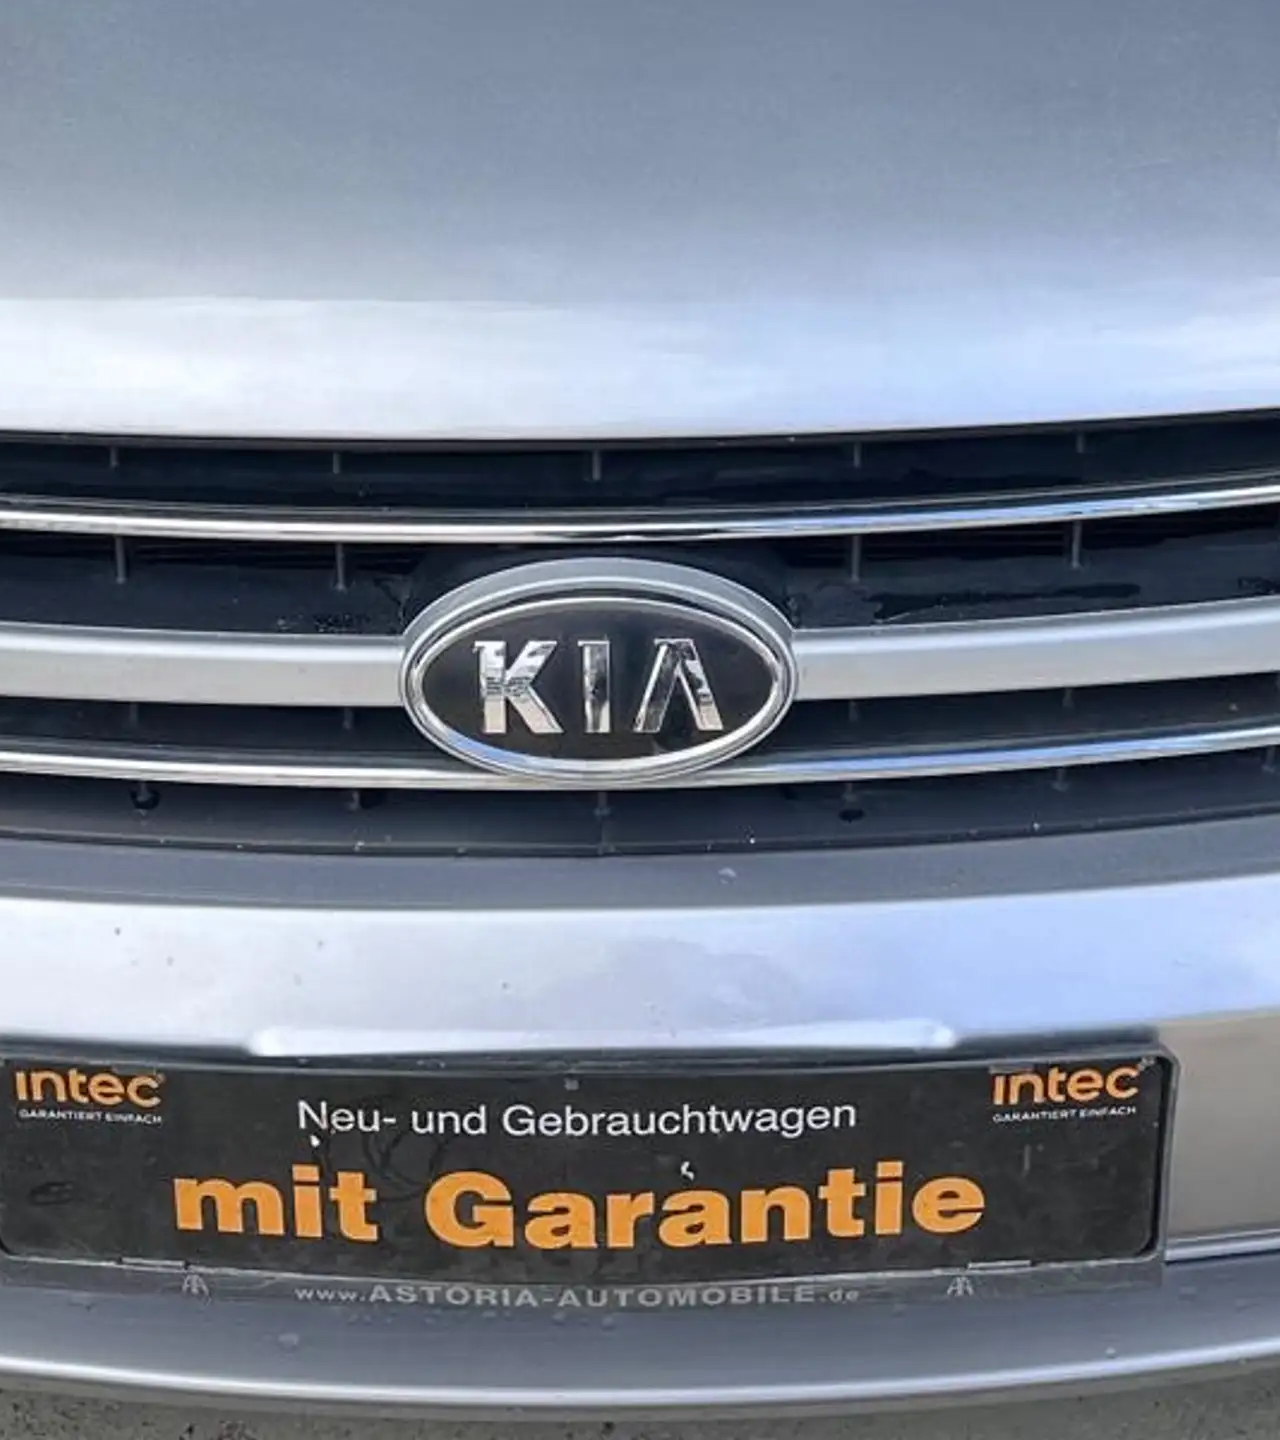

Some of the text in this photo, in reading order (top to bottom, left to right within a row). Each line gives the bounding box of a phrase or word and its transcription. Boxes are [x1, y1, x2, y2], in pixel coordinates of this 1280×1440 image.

[473, 637, 725, 734] KIA
[297, 1100, 856, 1139] Neu- und Gebrauchtwagen
[172, 1161, 988, 1248] mit Garantie
[294, 1285, 860, 1308] www.ASTORIA-AUTOMOBILE.de
